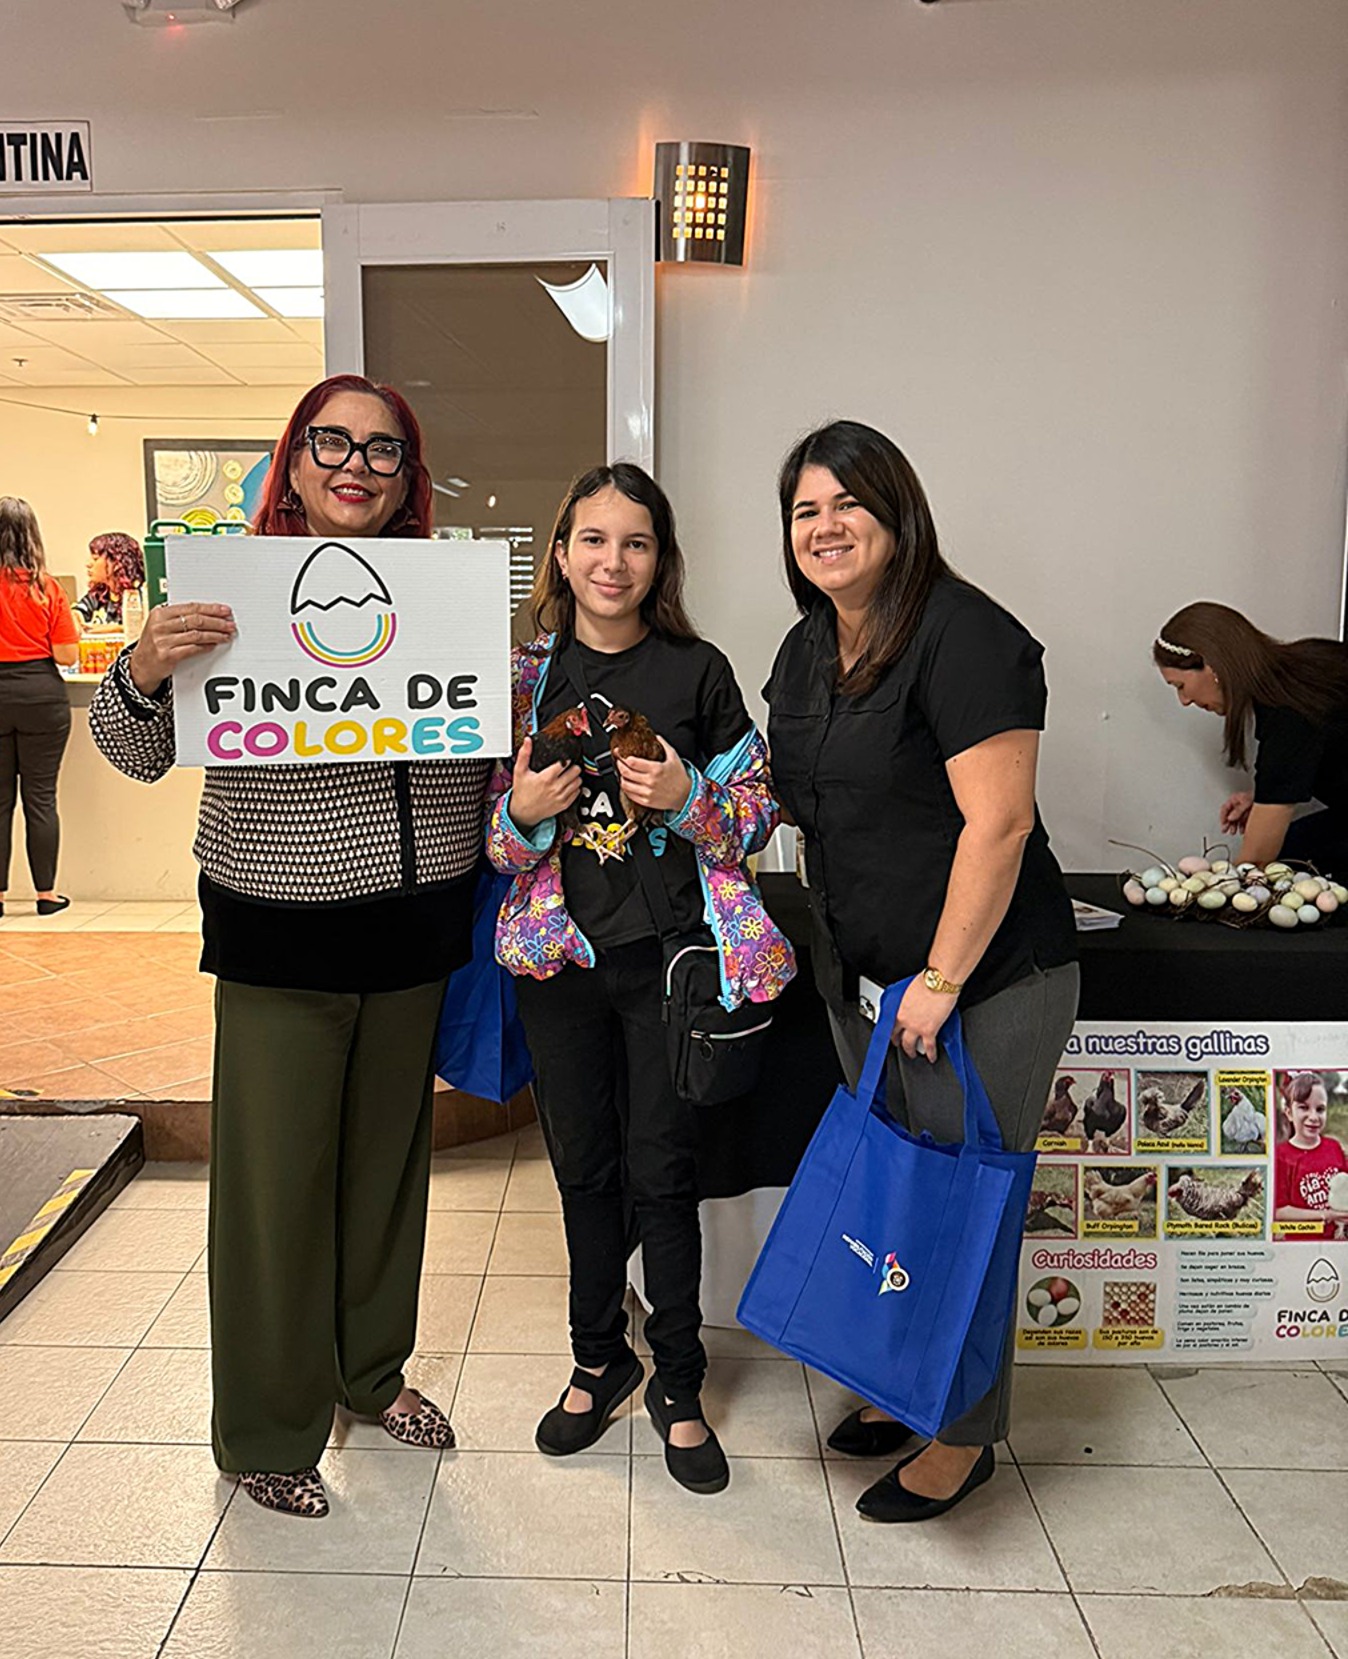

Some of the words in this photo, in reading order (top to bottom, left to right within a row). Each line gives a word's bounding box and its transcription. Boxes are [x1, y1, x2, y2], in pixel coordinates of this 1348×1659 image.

[0, 132, 89, 182] TINA
[204, 676, 381, 714] FINCA
[407, 674, 478, 710] DE
[207, 716, 484, 760] COLORES
[1085, 1030, 1181, 1055] nuestras
[1185, 1030, 1270, 1061] gallinas
[1086, 1223, 1100, 1231] Buff
[1102, 1223, 1134, 1231] Orpington
[1032, 1250, 1157, 1270] Curiosidades
[1277, 1310, 1330, 1323] FINCA
